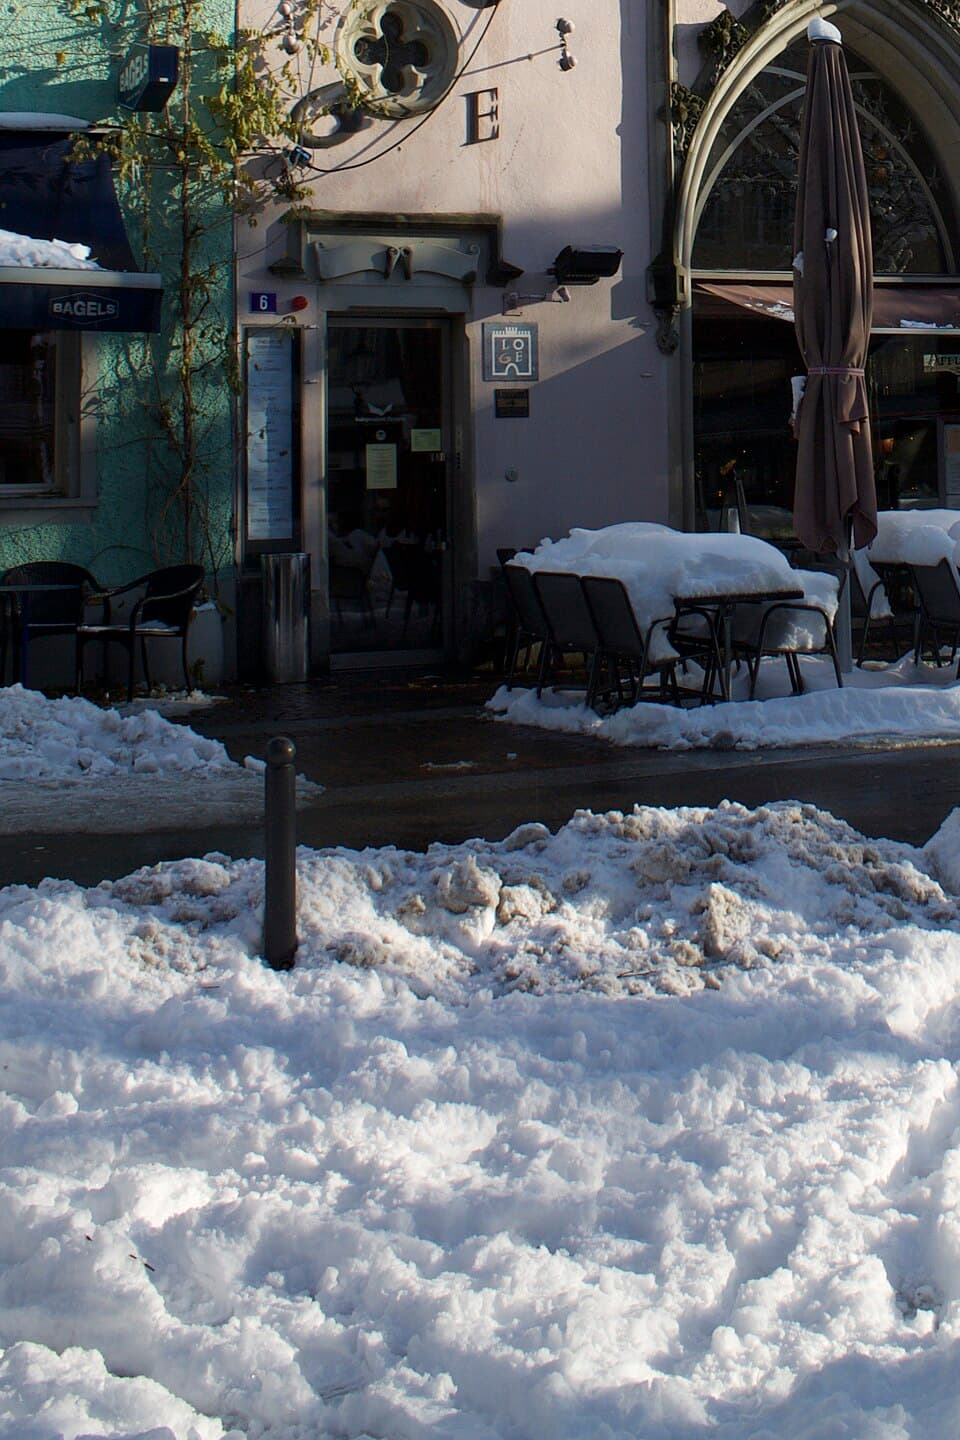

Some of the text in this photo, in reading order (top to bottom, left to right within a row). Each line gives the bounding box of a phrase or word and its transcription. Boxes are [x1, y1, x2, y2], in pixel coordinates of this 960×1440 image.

[119, 53, 149, 92] BAGELS
[53, 301, 116, 316] BAGELS
[259, 294, 269, 311] 6
